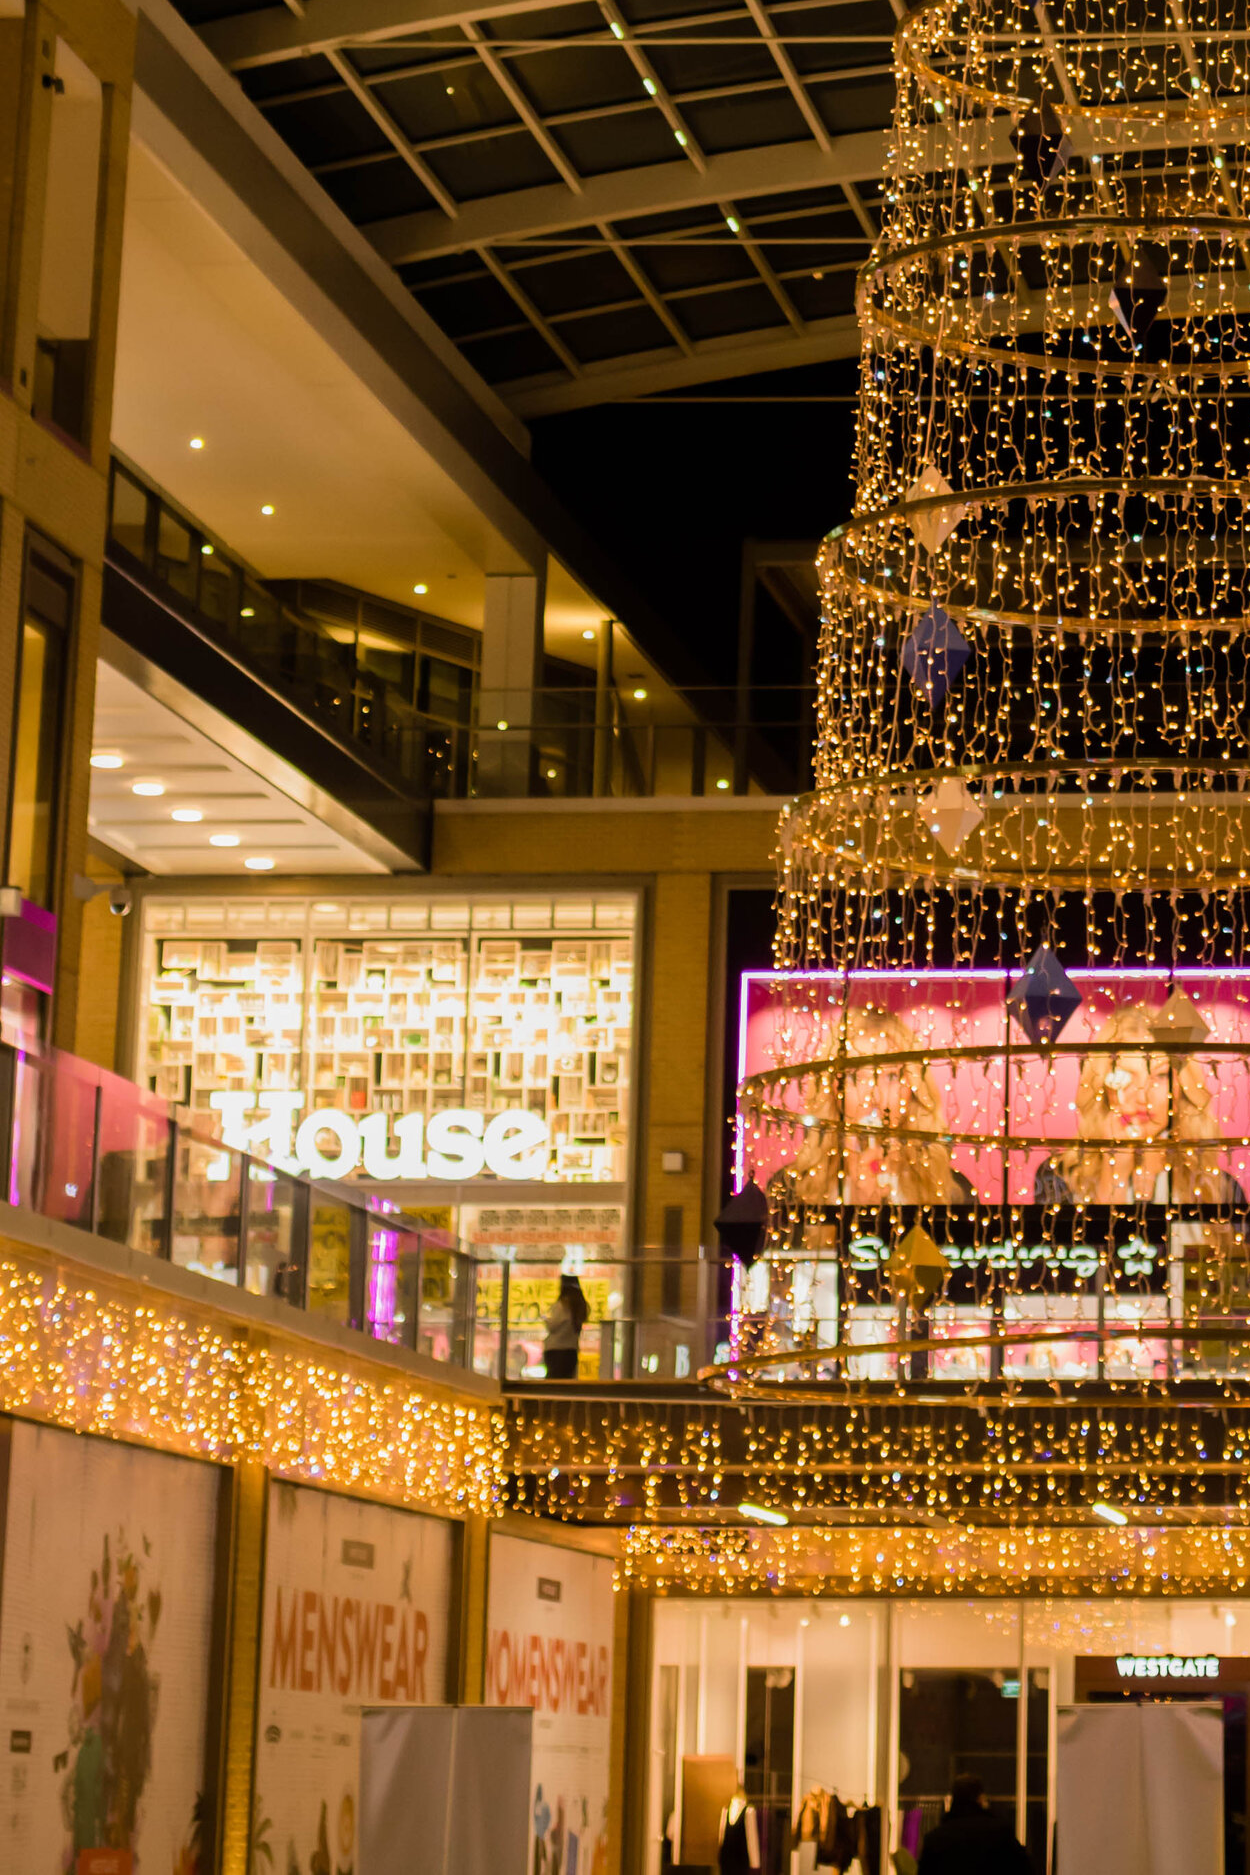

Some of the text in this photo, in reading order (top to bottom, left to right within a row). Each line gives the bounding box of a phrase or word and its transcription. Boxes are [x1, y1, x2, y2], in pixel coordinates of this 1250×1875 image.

[207, 1090, 548, 1181] House
[849, 1235, 1100, 1278] Serdrug
[269, 1583, 429, 1703] MENSWEAR
[486, 1628, 609, 1718] WOMENSWEAR
[1116, 1656, 1220, 1678] WESTGATE
